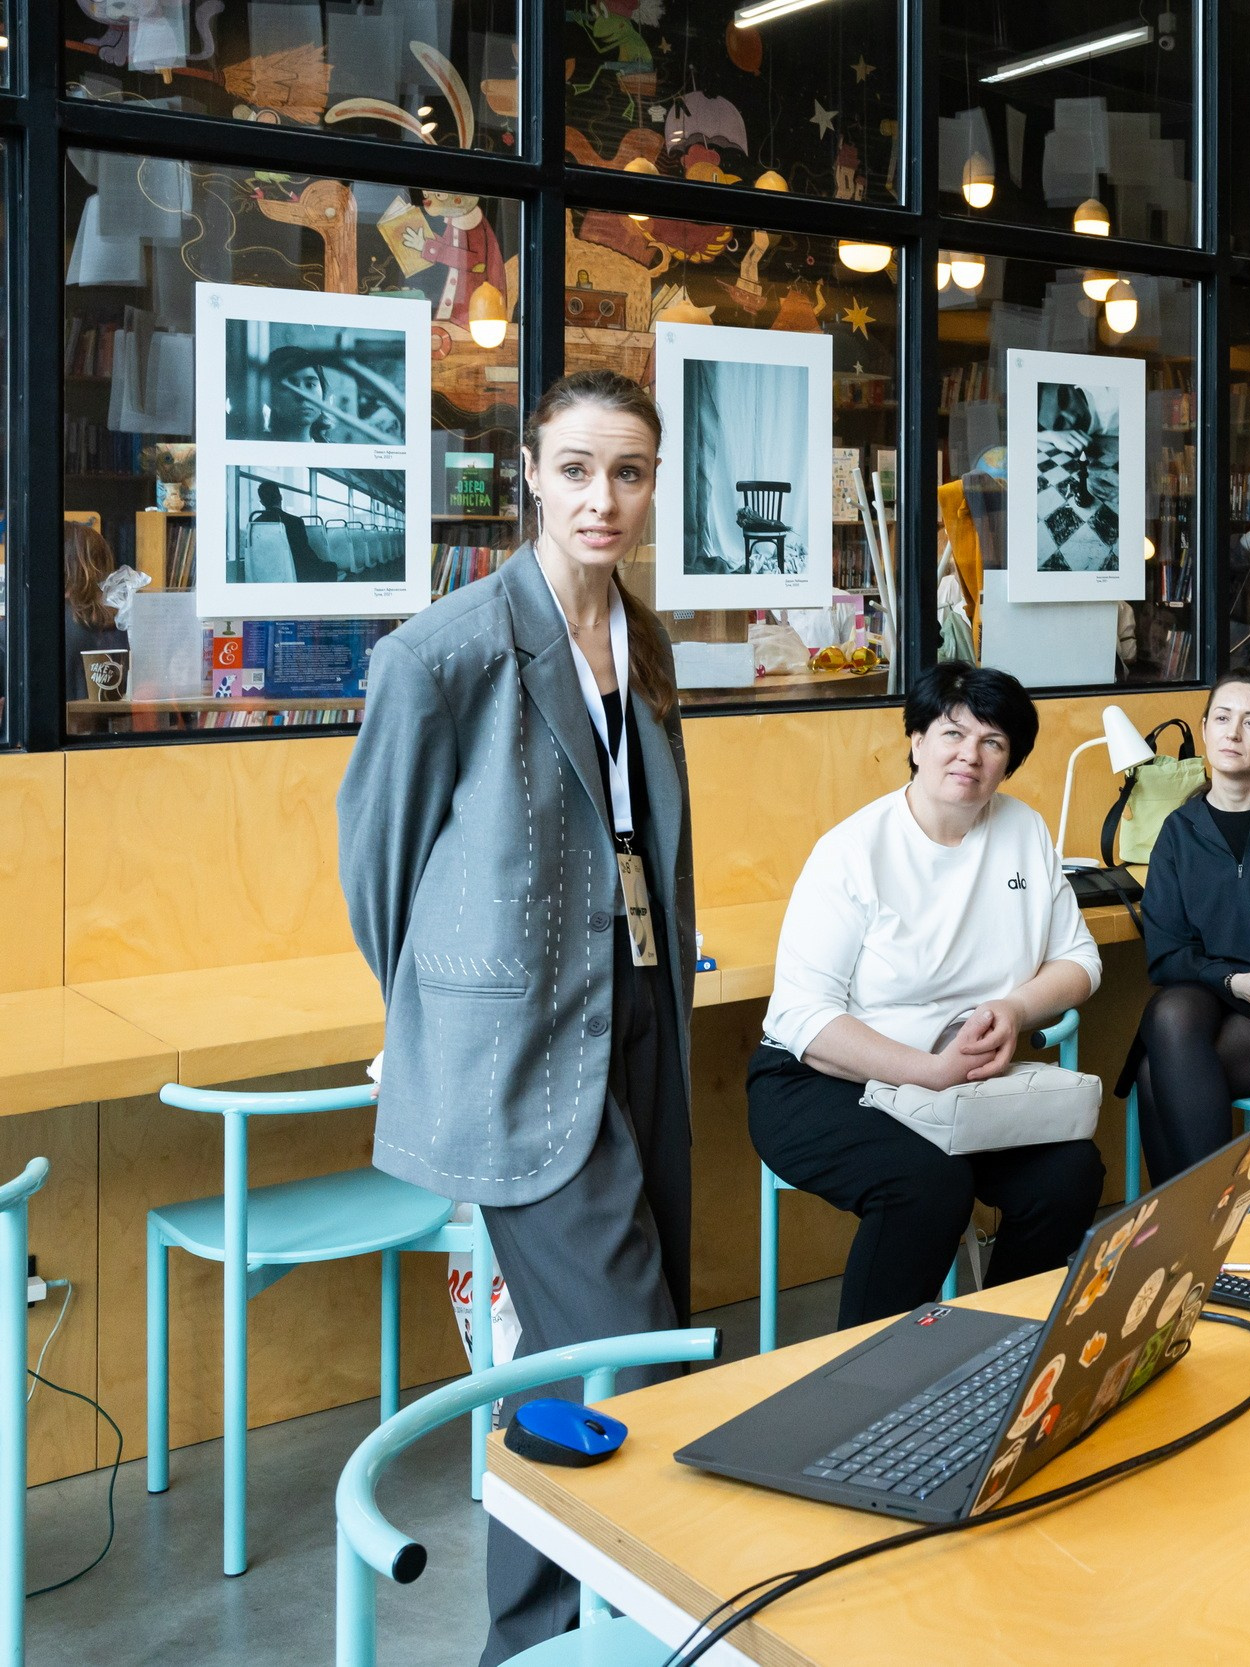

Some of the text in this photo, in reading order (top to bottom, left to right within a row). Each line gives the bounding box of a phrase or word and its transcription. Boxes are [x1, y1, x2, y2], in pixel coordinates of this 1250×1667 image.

[456, 480, 485, 493] ОЗЕРО
[90, 662, 110, 674] TAKE
[90, 673, 114, 684] AWAY
[1007, 871, 1027, 890] alo
